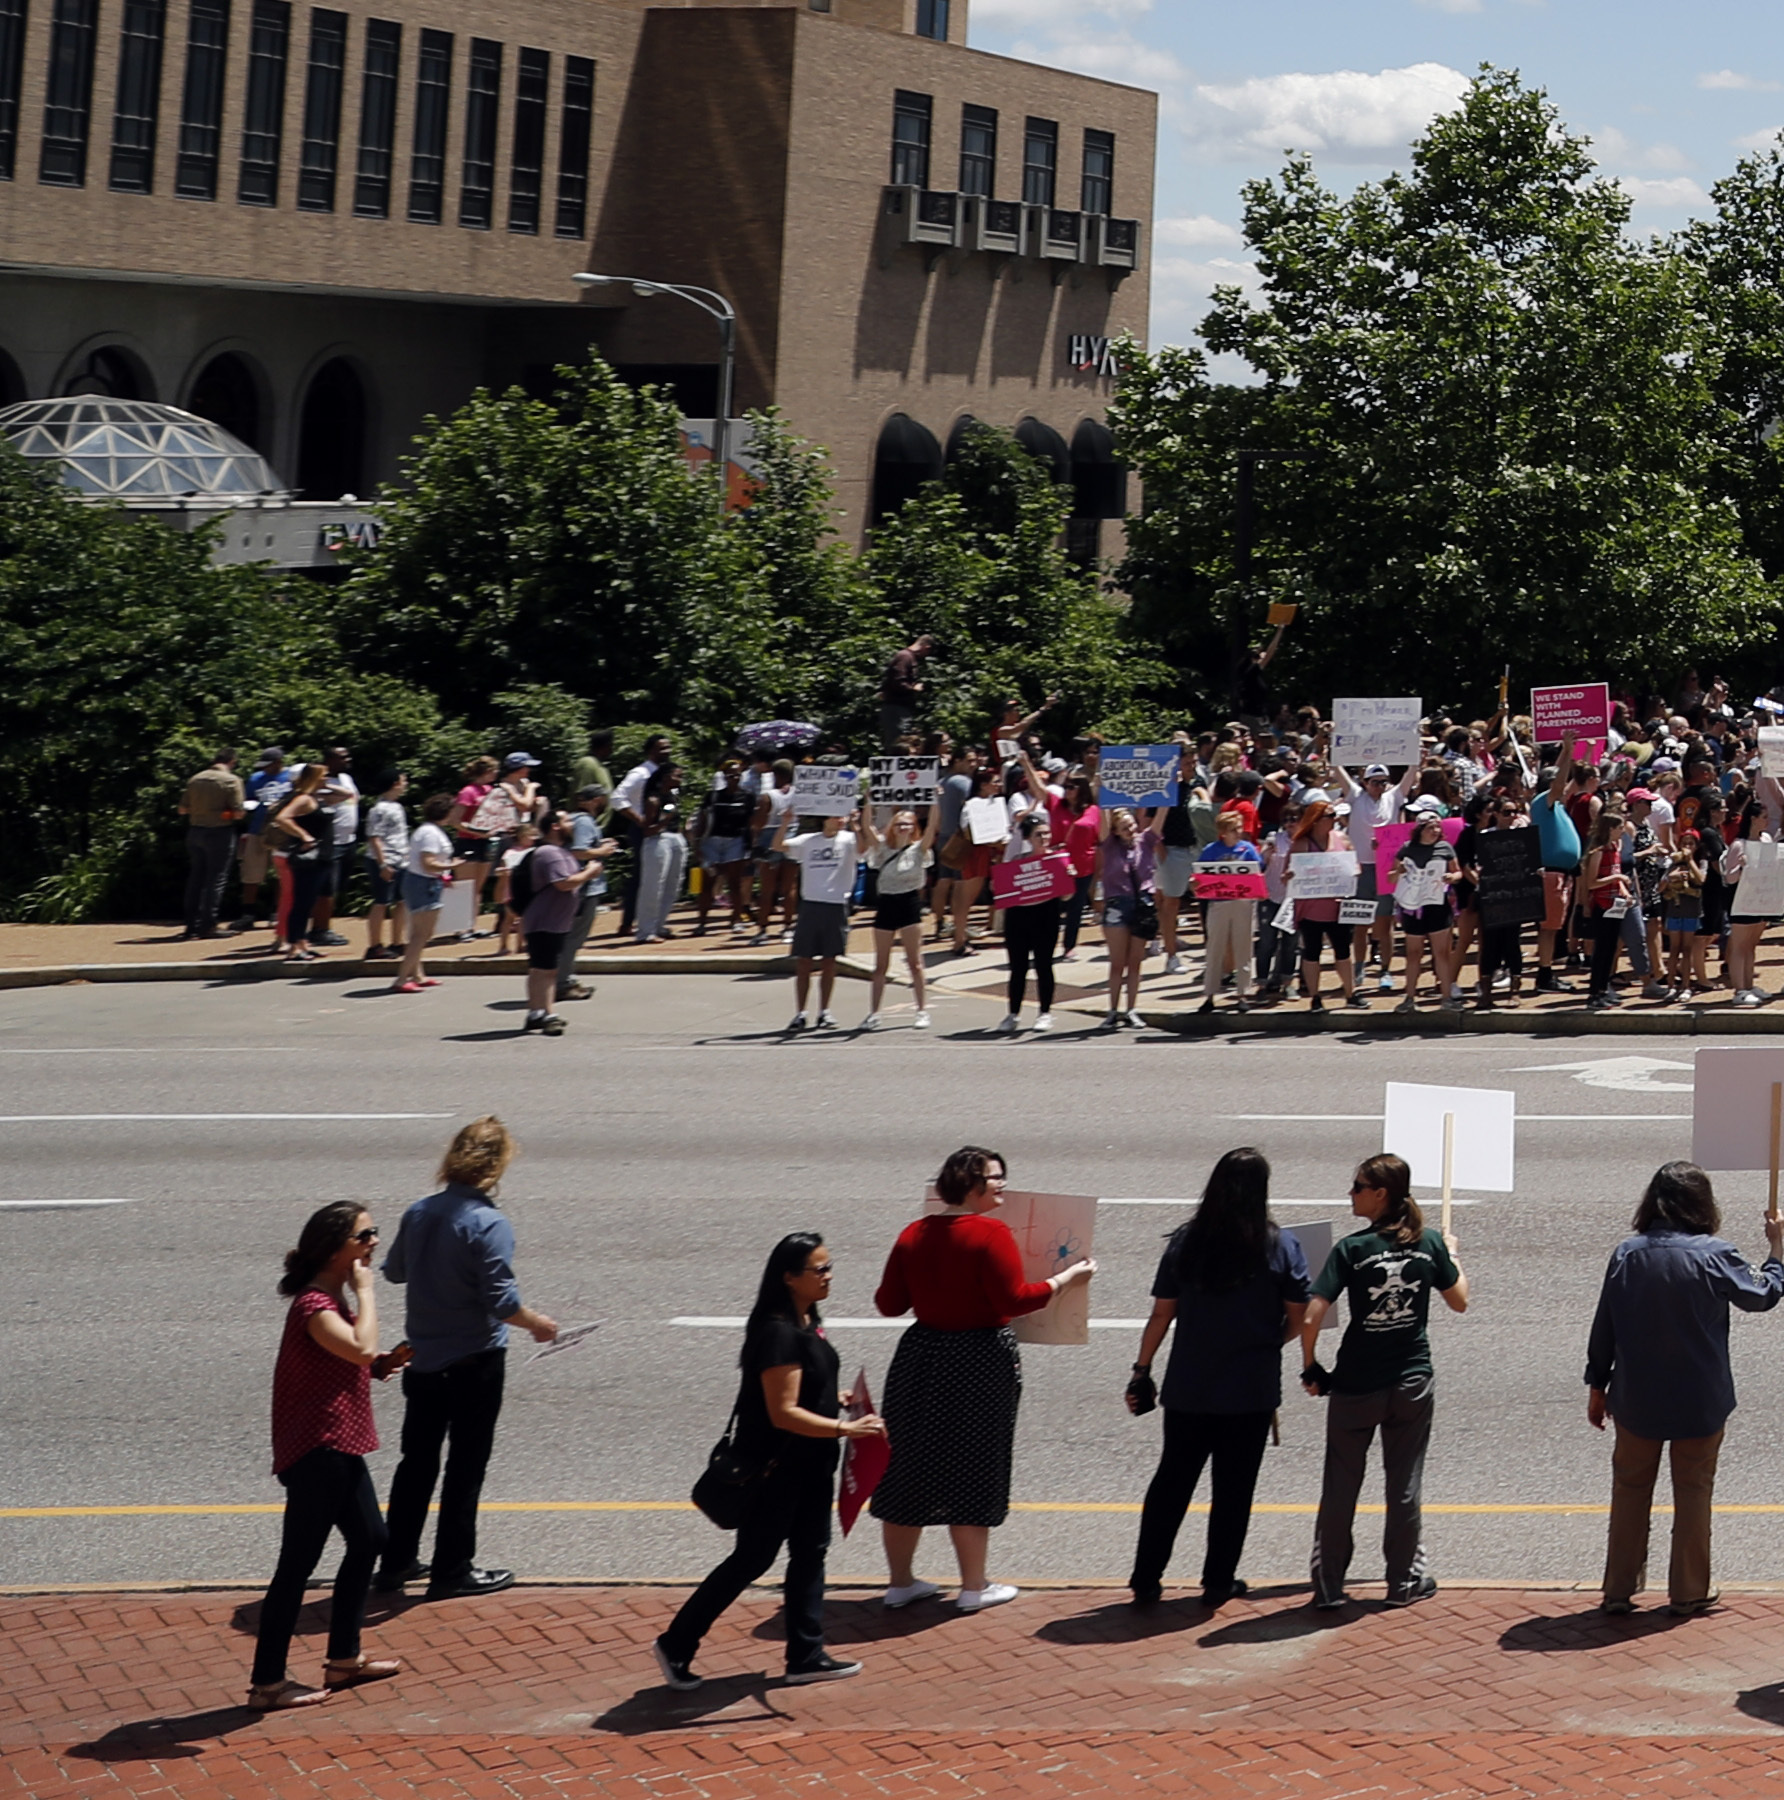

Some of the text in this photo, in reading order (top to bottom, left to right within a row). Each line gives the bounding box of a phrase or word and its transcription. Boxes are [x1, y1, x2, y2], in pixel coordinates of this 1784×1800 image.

[1071, 335, 1138, 375] HYA
[1535, 691, 1585, 702] WE STAND
[1536, 703, 1562, 711] WITH
[1537, 709, 1581, 719] PLANNED
[1537, 716, 1603, 728] PARENTHOOD
[871, 758, 933, 771] MY BODY
[797, 768, 836, 780] WHAT
[871, 774, 894, 785] MY
[796, 783, 855, 797] SHE SAID
[871, 789, 934, 802] CHOICE
[1020, 861, 1042, 872] WE
[1341, 911, 1373, 919] AGAIN
